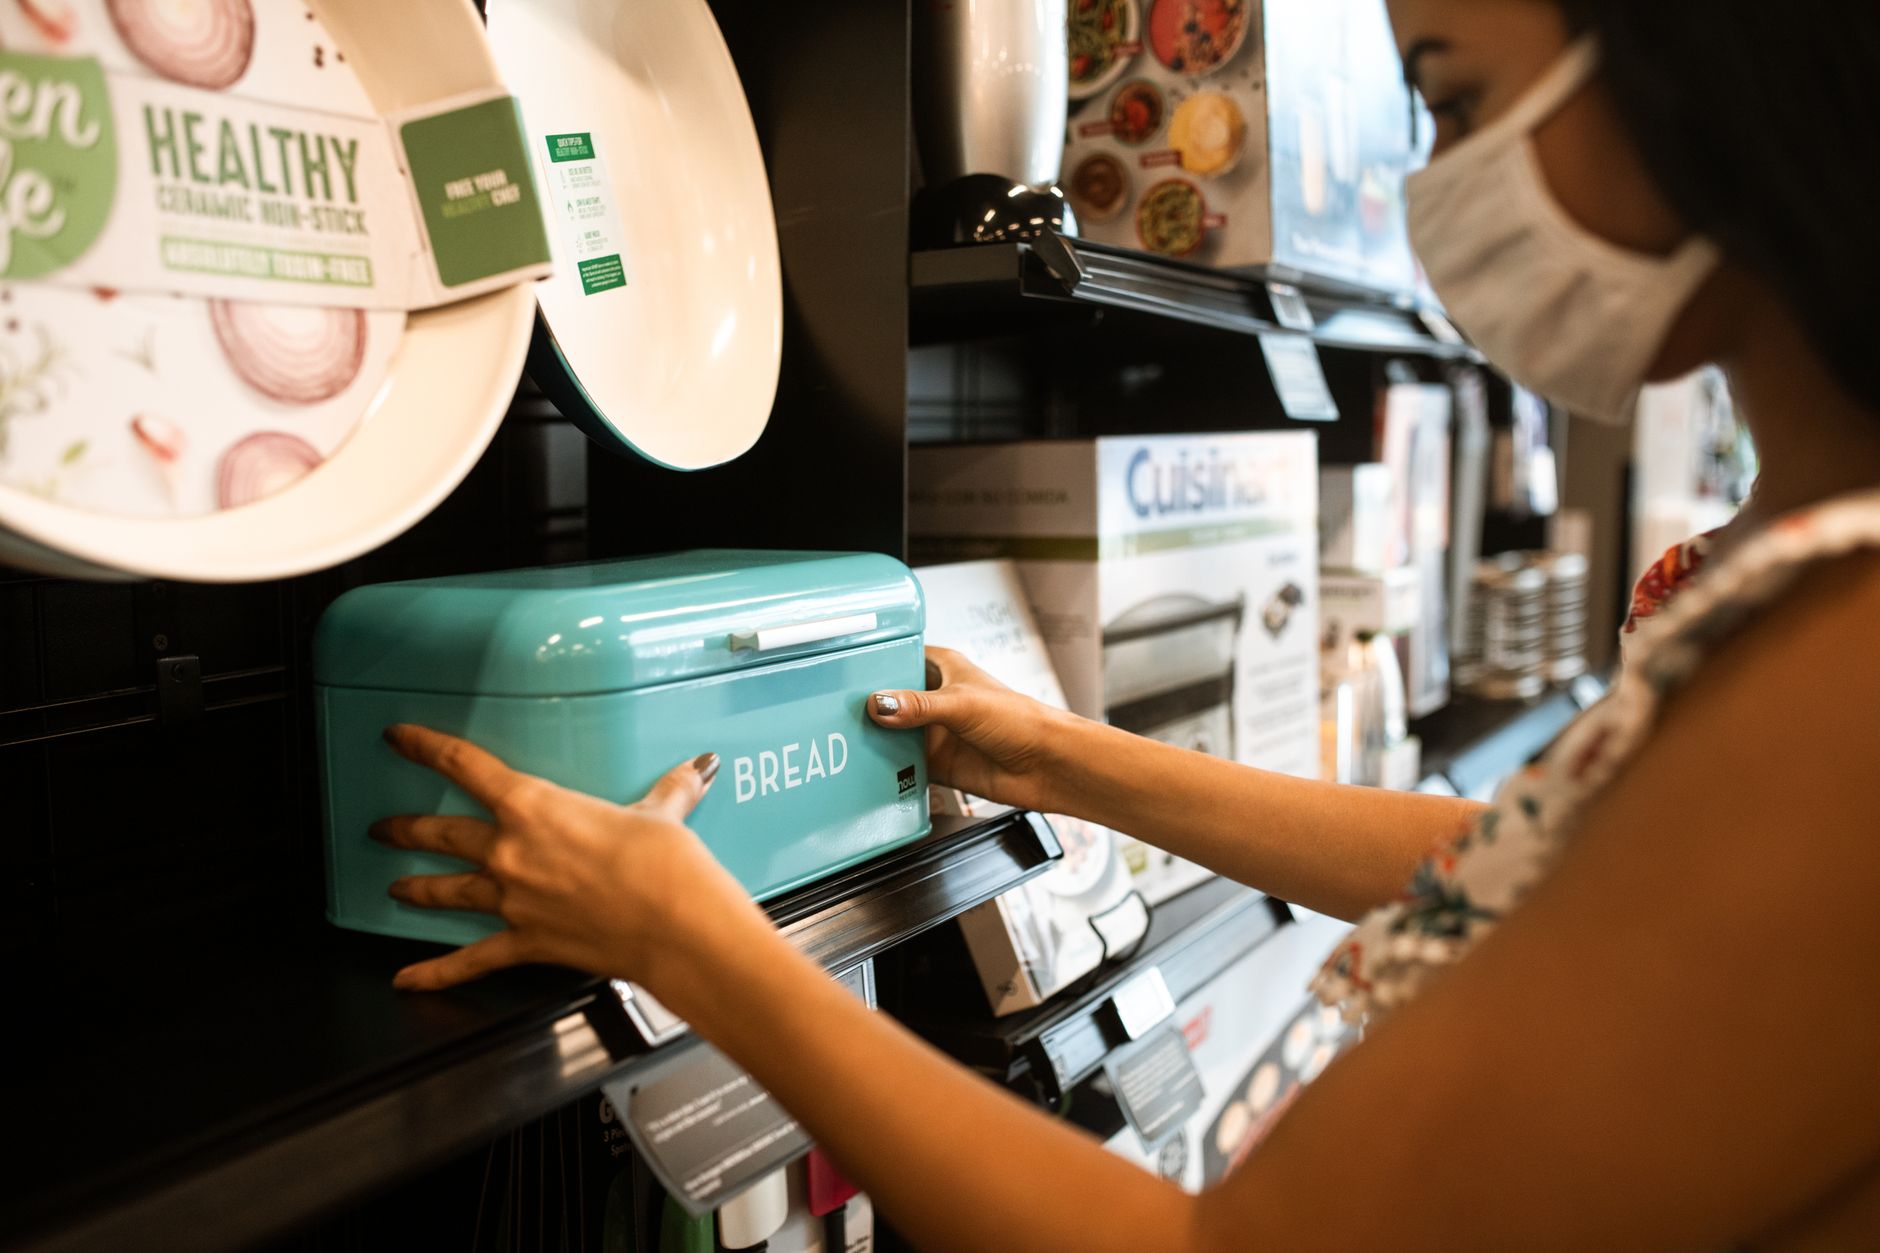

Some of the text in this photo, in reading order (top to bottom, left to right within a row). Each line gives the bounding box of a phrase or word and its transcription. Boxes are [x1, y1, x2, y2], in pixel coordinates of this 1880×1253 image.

[143, 104, 358, 203] HEALTHY
[473, 169, 508, 194] YOUR
[156, 183, 253, 223] CERAMIC
[259, 199, 369, 235] NON-STICK
[733, 732, 848, 804] BREAD
